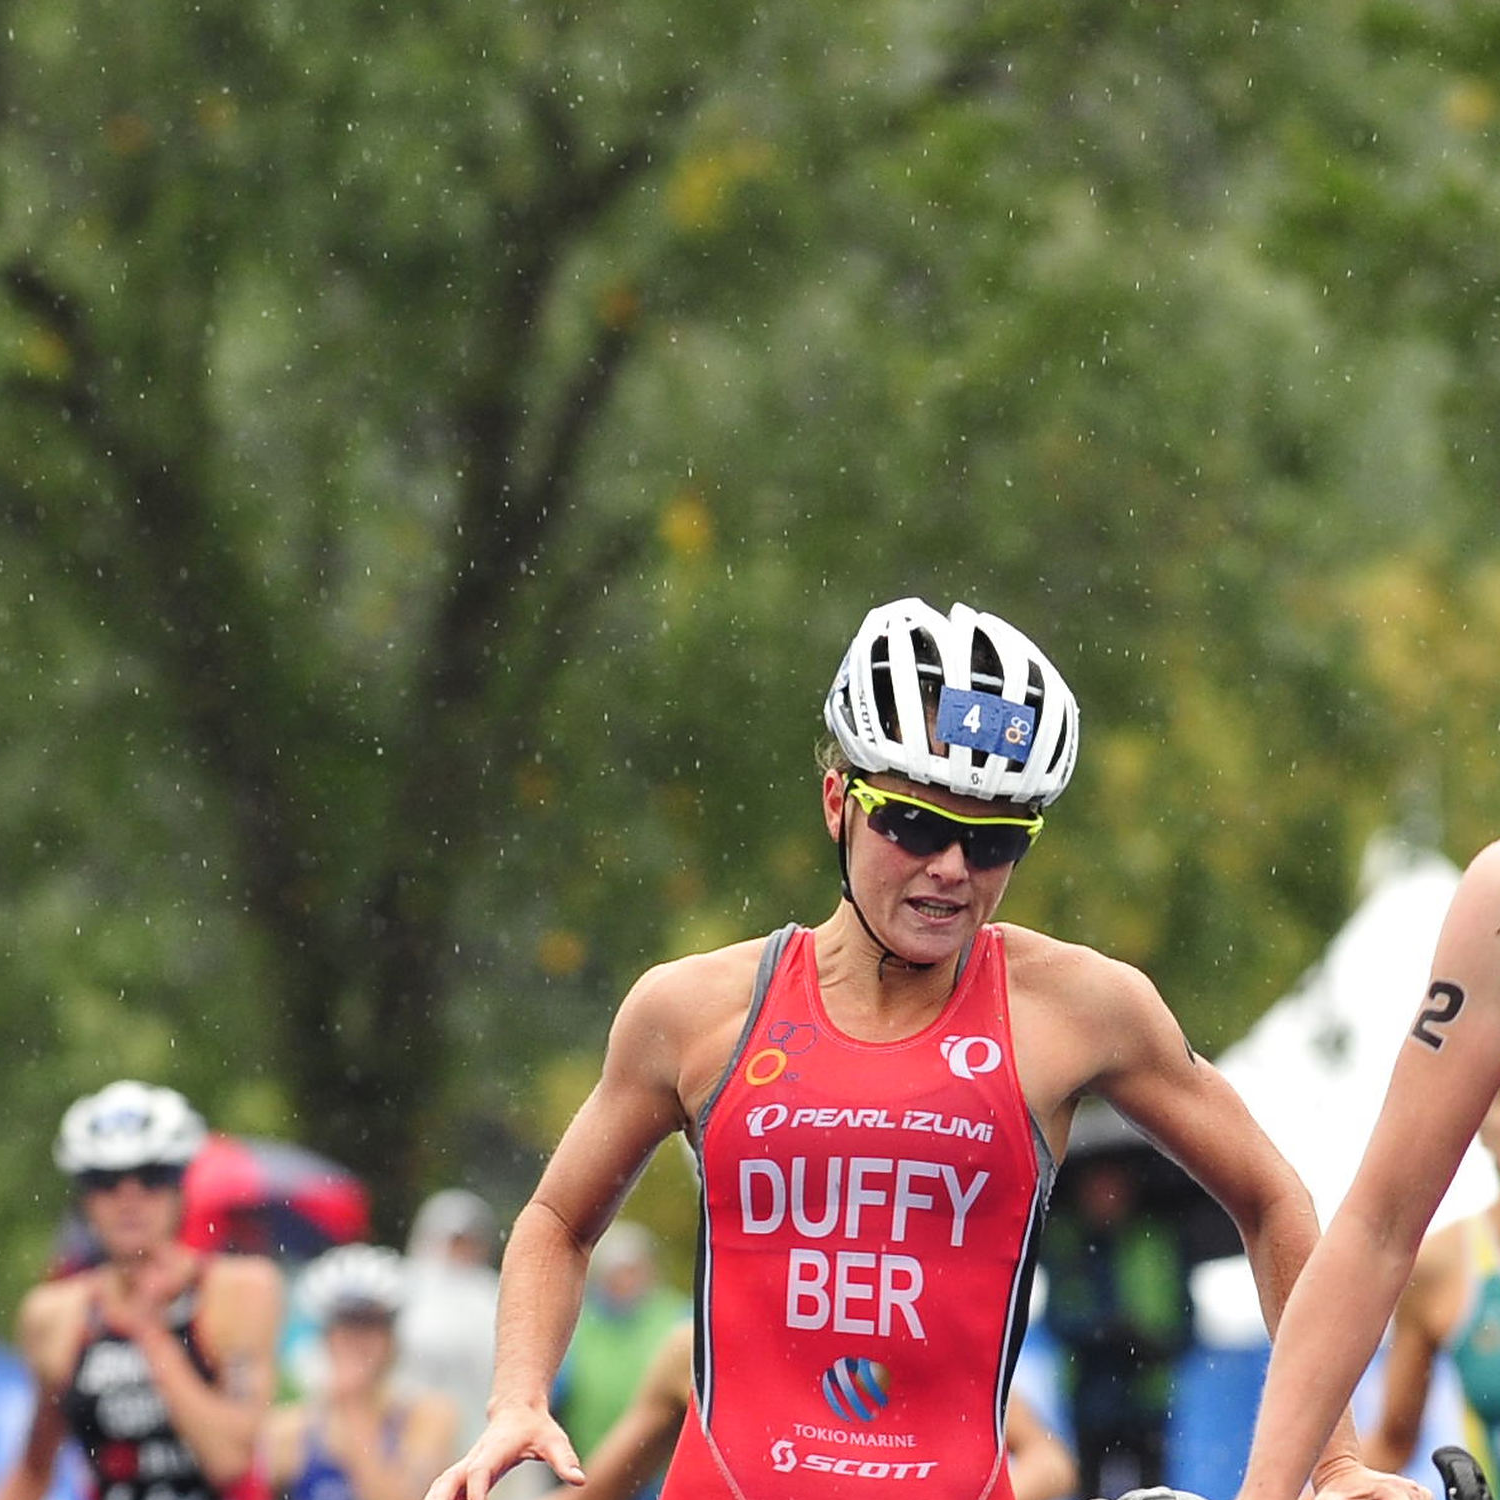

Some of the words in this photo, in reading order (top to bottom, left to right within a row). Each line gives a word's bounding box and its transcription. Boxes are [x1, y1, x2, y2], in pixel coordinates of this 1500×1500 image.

[962, 704, 982, 734] 4
[1411, 980, 1466, 1051] 2
[790, 1108, 896, 1129] PEARL
[739, 1156, 990, 1247] DUFFY
[786, 1248, 926, 1339] BER
[793, 1424, 849, 1444] TOKIO
[849, 1432, 917, 1448] MARINE
[801, 1455, 940, 1480] SCOTT
